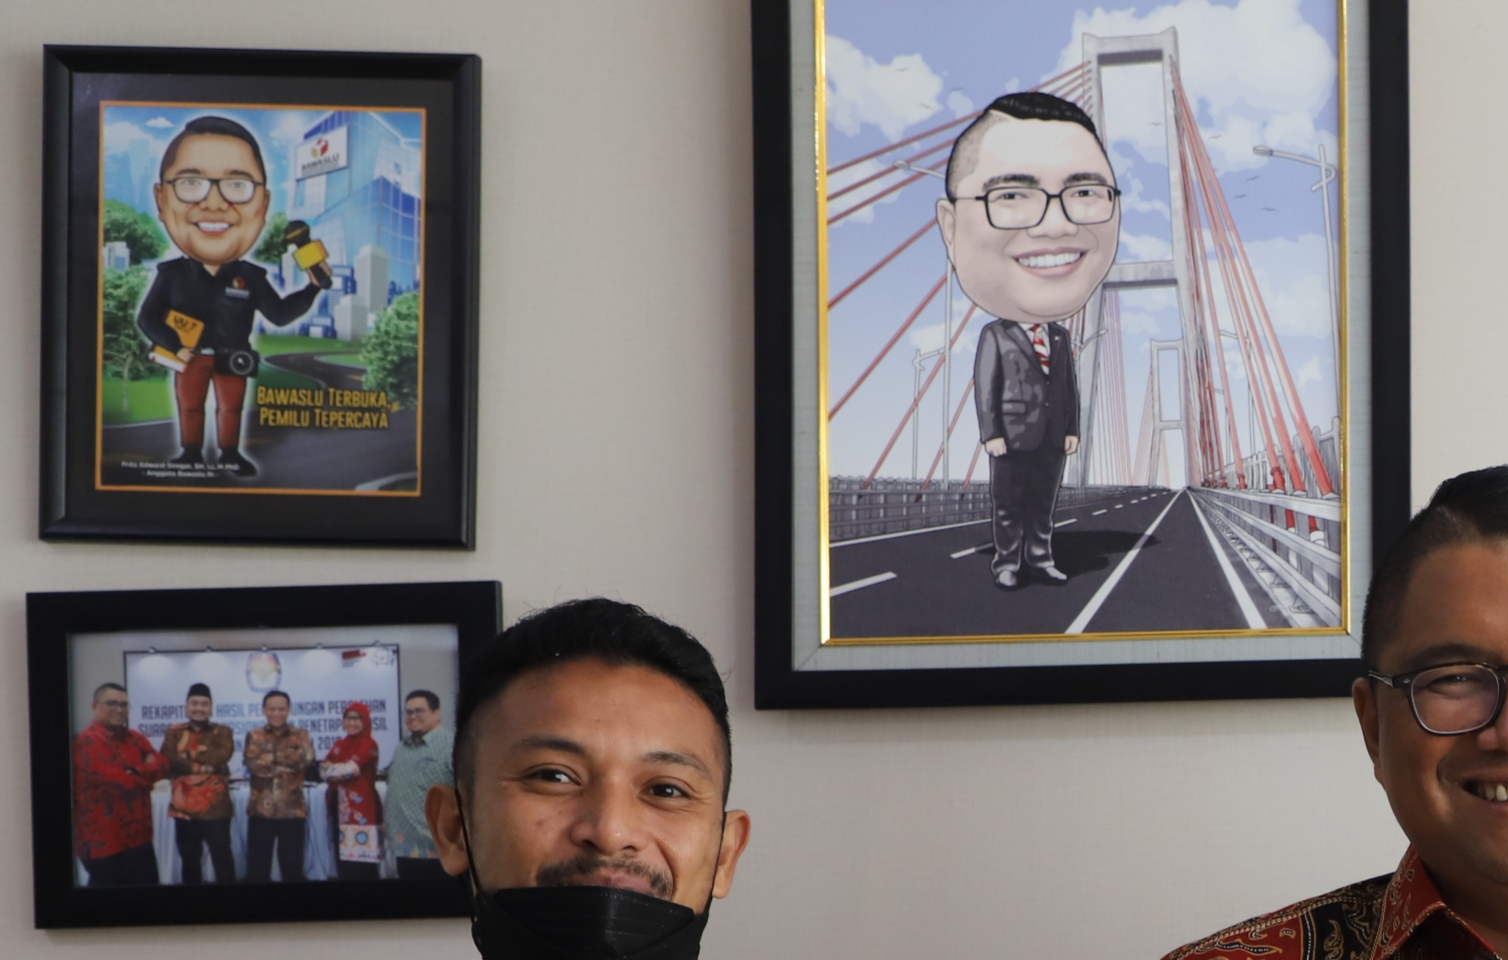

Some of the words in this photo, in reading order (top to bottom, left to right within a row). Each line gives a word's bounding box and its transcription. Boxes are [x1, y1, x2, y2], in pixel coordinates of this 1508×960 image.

[257, 386, 324, 406] BAWASLU
[259, 407, 310, 427] PEMILU
[314, 408, 389, 429] TEPERCAYA
[216, 703, 245, 718] HASIL
[298, 717, 343, 734] PENETAP
[372, 716, 388, 731] SIL
